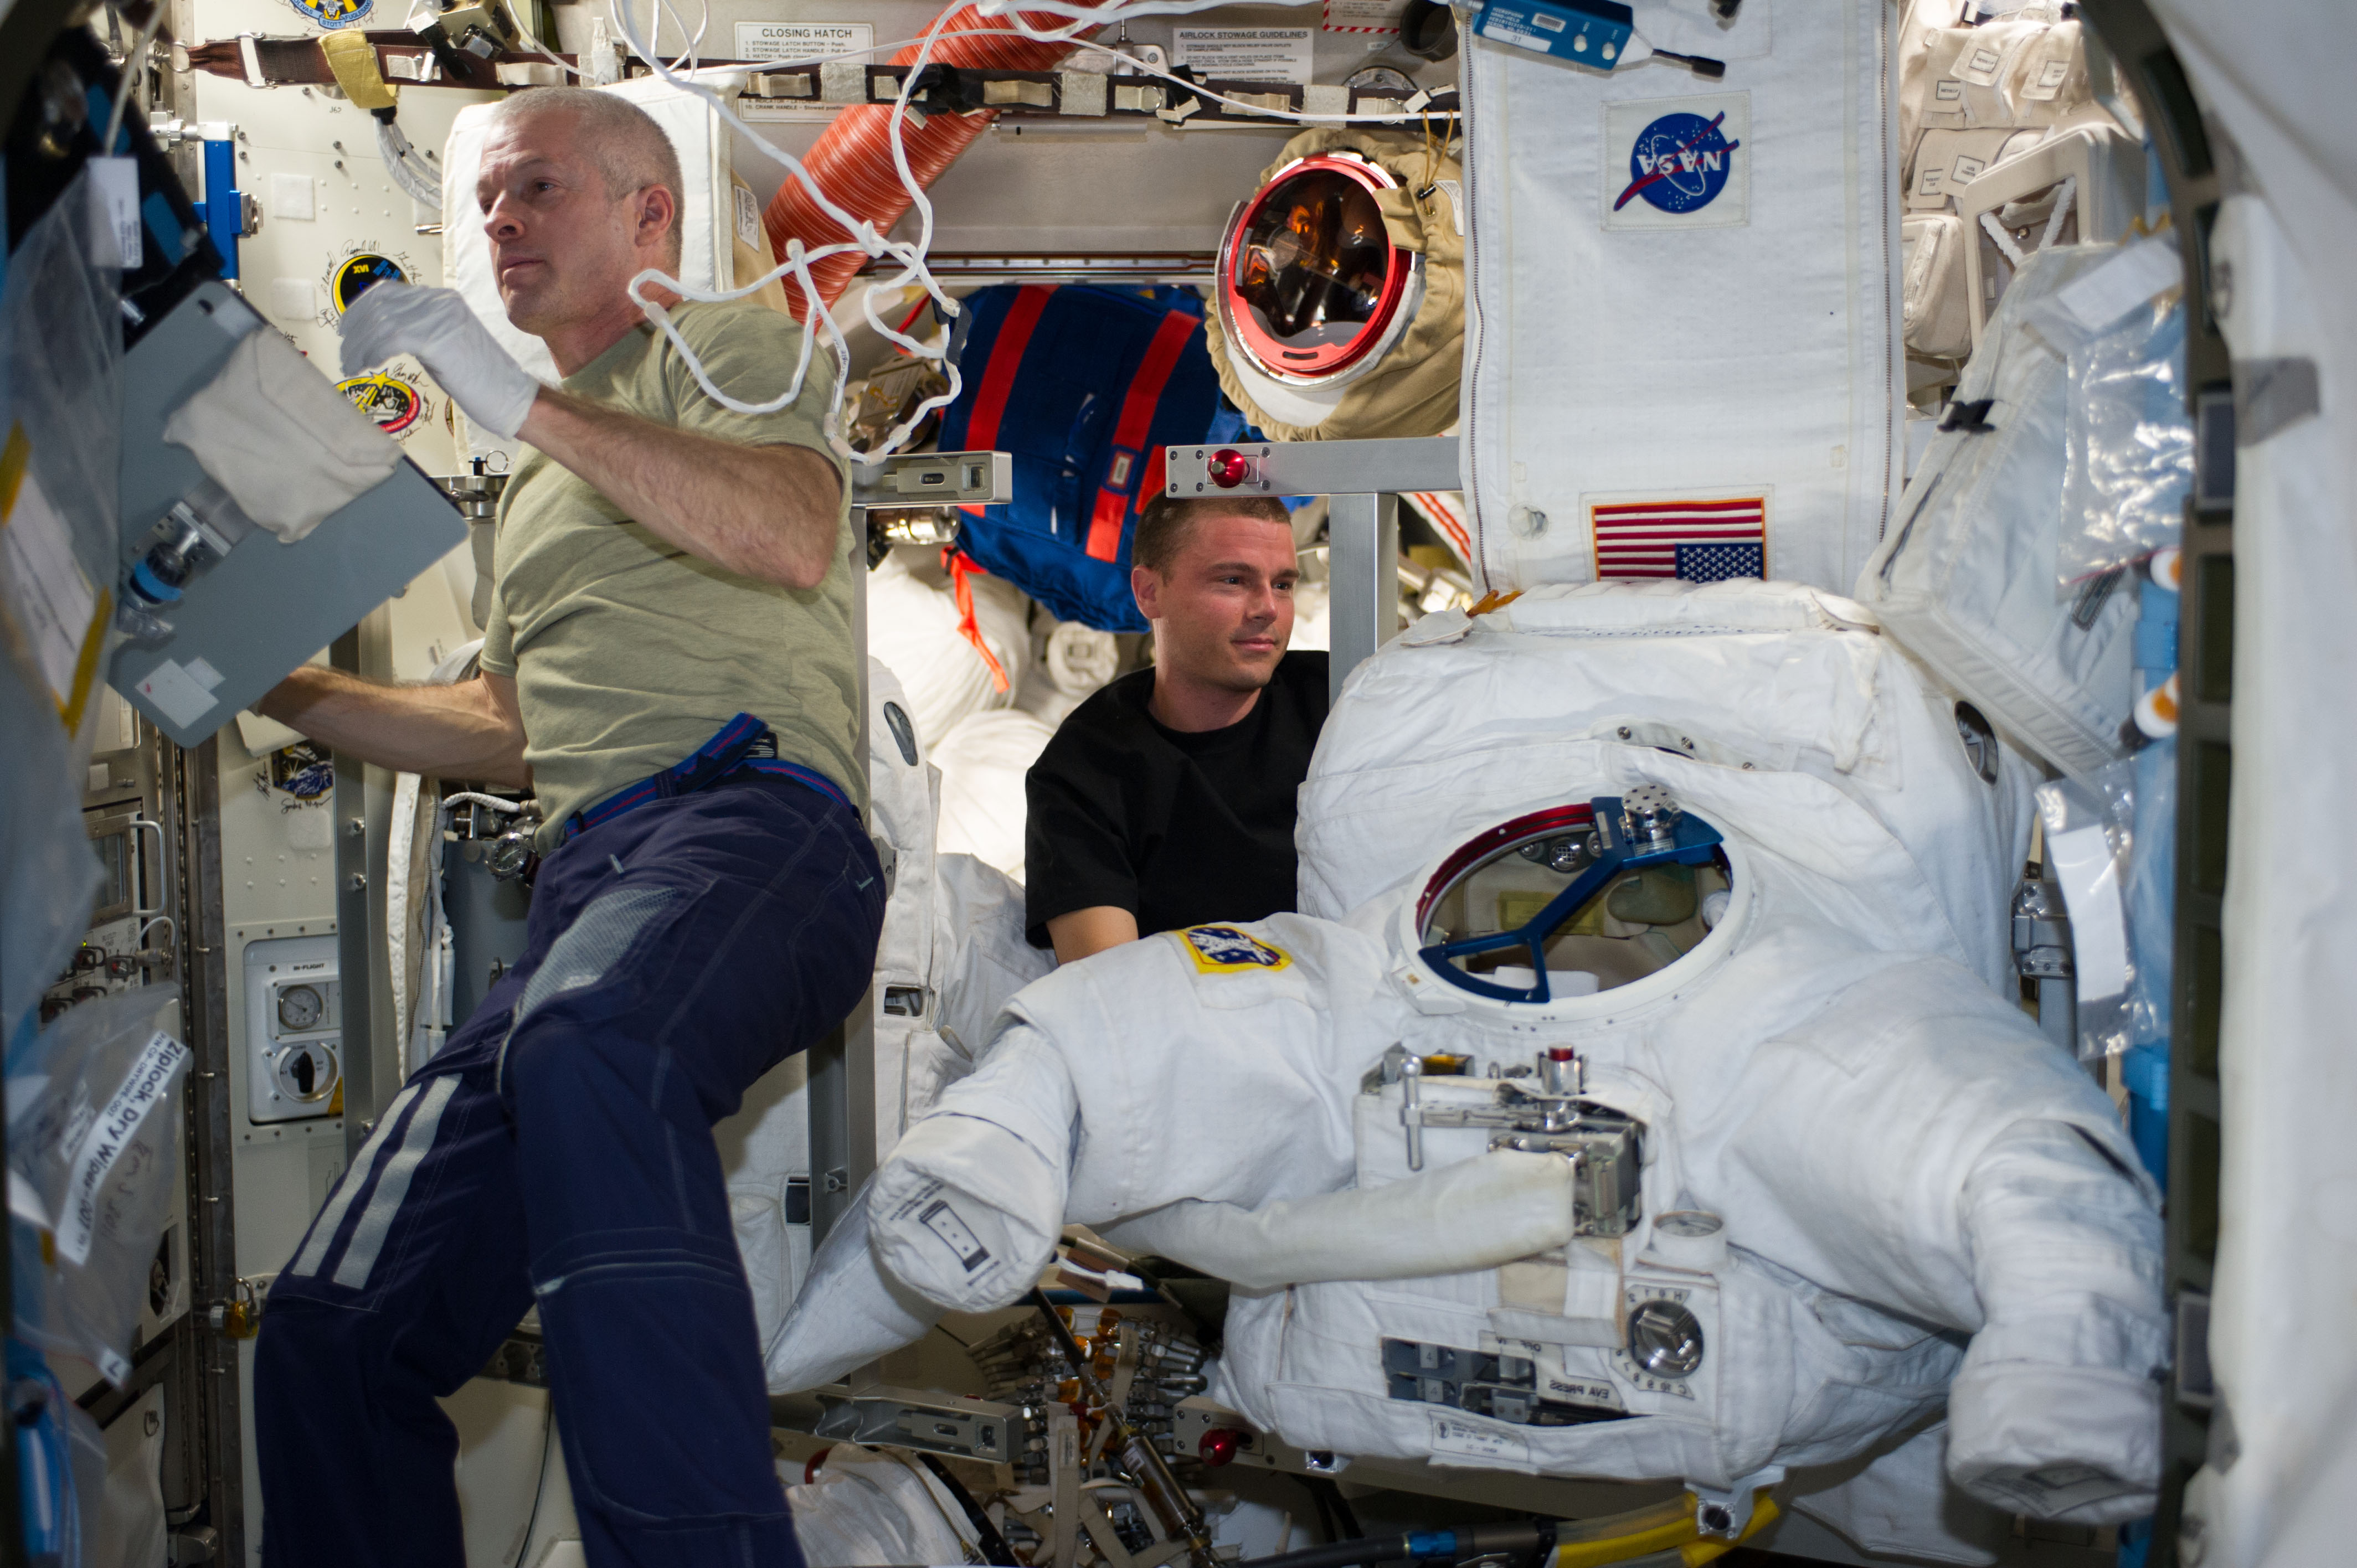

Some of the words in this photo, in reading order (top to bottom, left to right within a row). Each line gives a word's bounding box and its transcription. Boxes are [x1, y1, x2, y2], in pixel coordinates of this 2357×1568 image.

[294, 0, 313, 15] OLIVAS
[762, 28, 811, 38] CLOSING
[815, 29, 852, 38] HATCH
[330, 106, 342, 114] J62
[1636, 151, 1722, 175] NASA
[353, 264, 370, 274] XVI
[130, 1040, 184, 1103] Ziplock,
[107, 1107, 140, 1142] Dry
